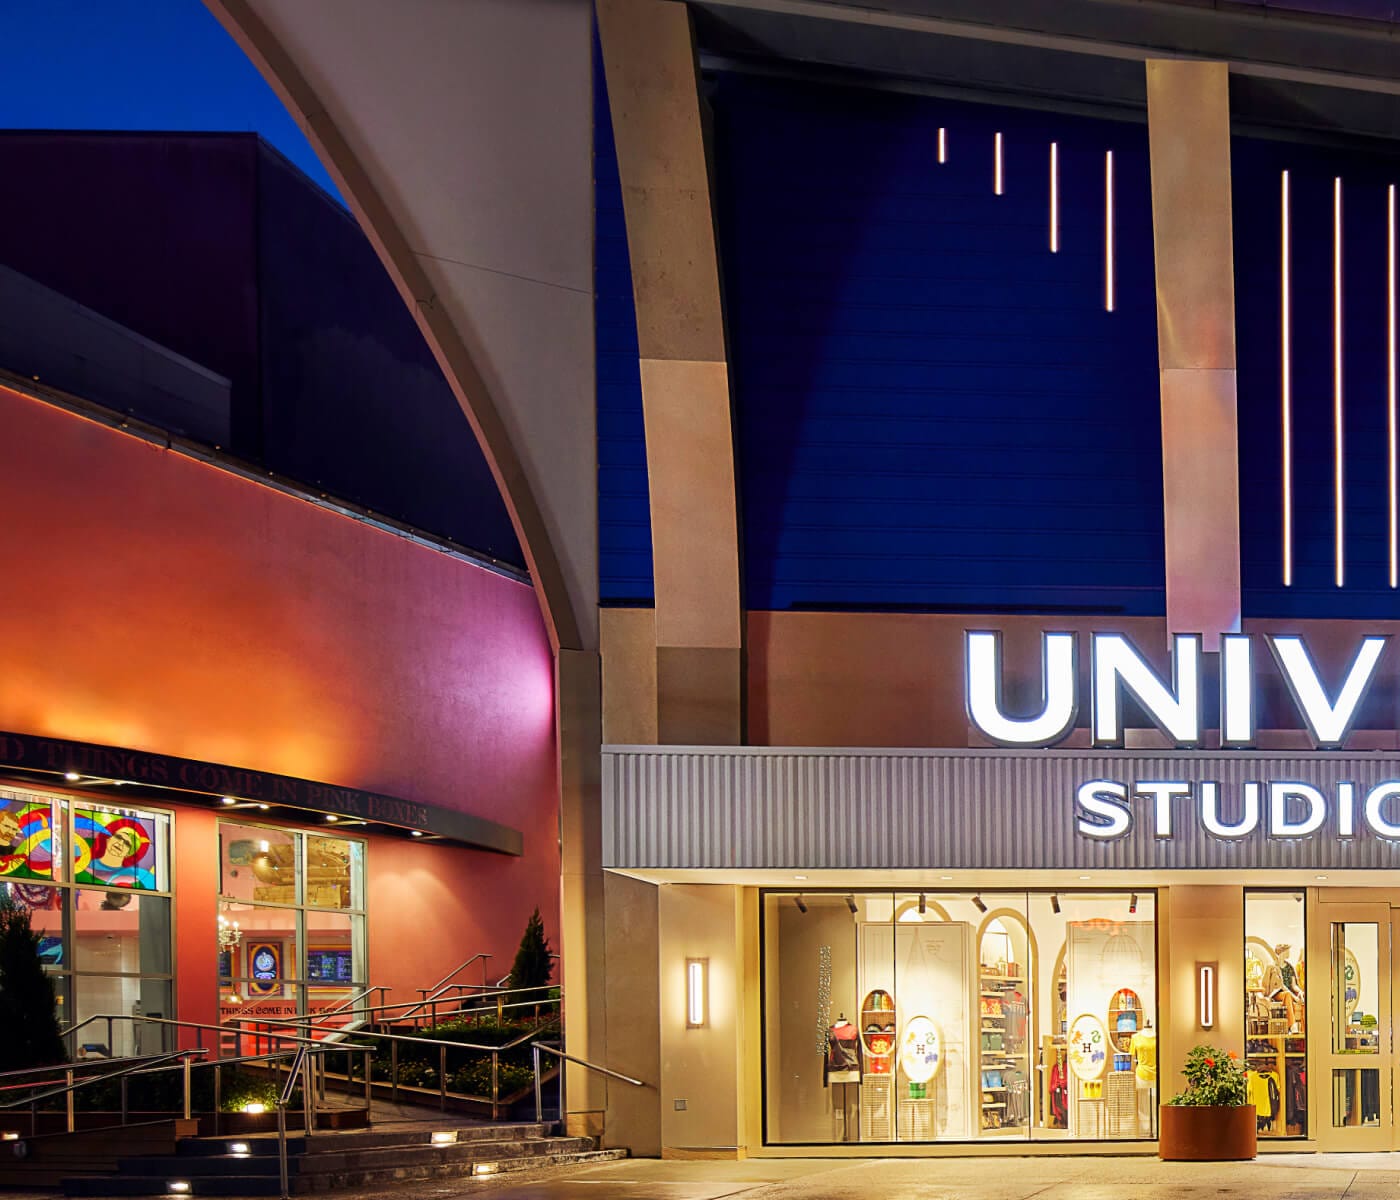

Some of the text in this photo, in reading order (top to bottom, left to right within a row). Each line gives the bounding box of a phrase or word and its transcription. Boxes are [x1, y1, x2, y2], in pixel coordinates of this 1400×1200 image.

[38, 741, 169, 780] THINGS
[179, 762, 263, 796] COME
[272, 778, 298, 801] IN
[305, 784, 361, 815] PINK
[367, 796, 429, 826] BOXES
